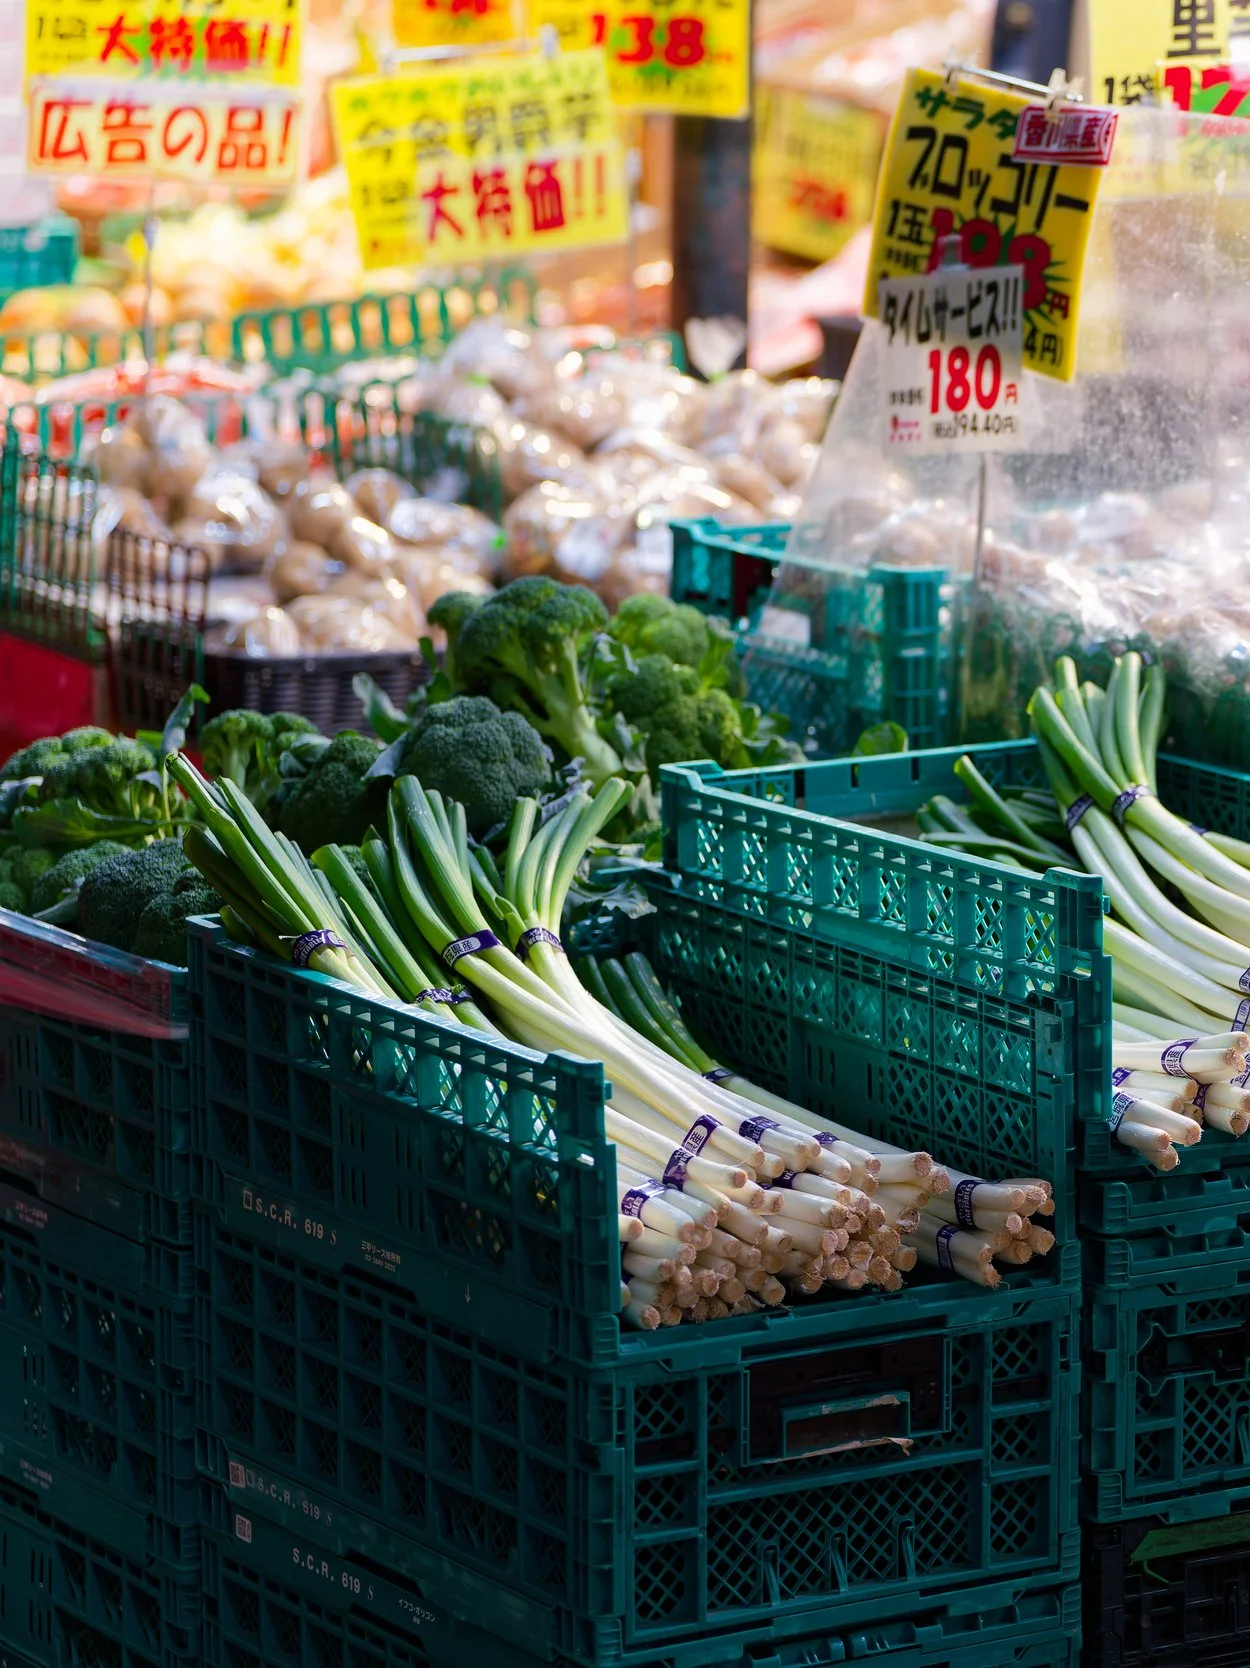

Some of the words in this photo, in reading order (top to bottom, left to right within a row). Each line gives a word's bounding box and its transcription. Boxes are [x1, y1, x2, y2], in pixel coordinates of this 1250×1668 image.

[592, 14, 705, 67] 138
[255, 1197, 297, 1229] S.C.R.
[304, 1218, 324, 1240] 619
[257, 1477, 296, 1509] S.C.R.
[302, 1500, 320, 1520] 619
[292, 1547, 335, 1582] S.C.R.
[341, 1572, 361, 1594] 619
